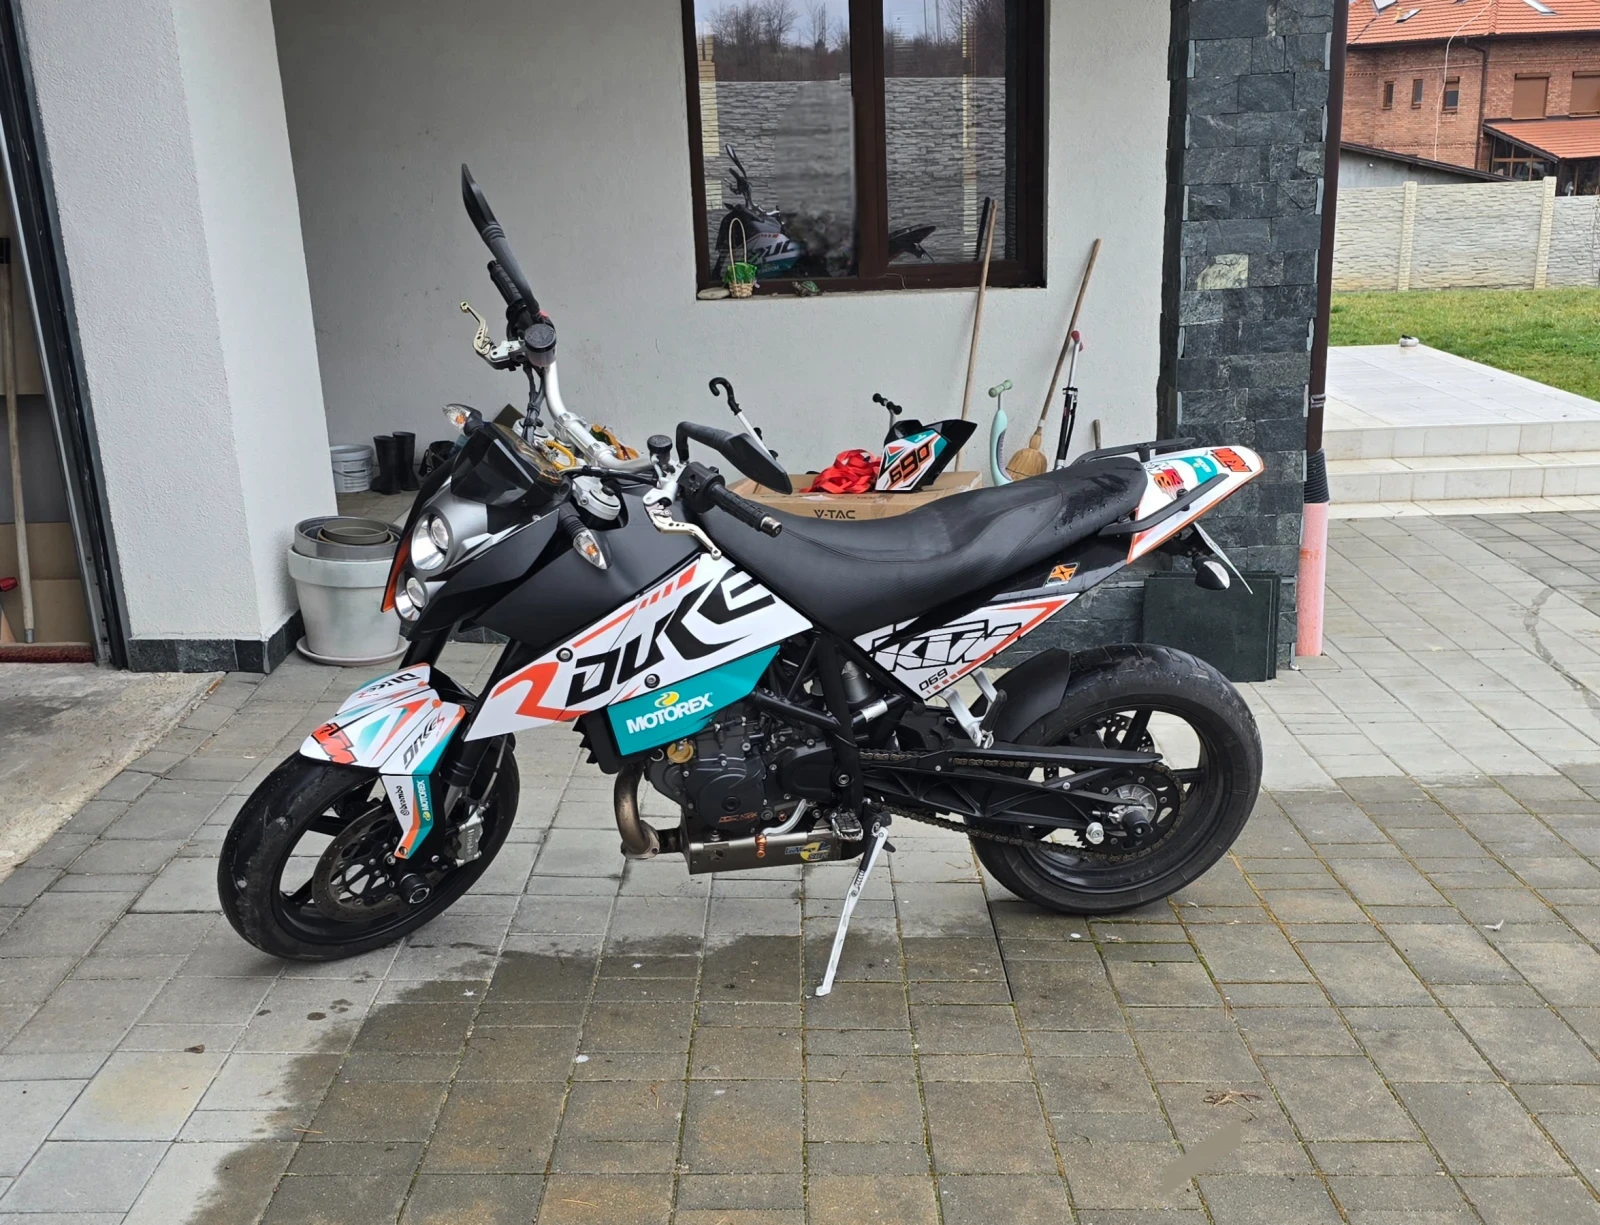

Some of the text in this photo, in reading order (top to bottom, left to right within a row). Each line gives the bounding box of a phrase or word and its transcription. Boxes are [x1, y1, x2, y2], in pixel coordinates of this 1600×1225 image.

[889, 441, 932, 484] 690
[813, 509, 856, 520] V-TAC
[565, 566, 777, 708] DUKE
[869, 618, 1022, 673] KTM
[626, 693, 715, 734] MOTOREX
[416, 779, 430, 811] MOTOREX
